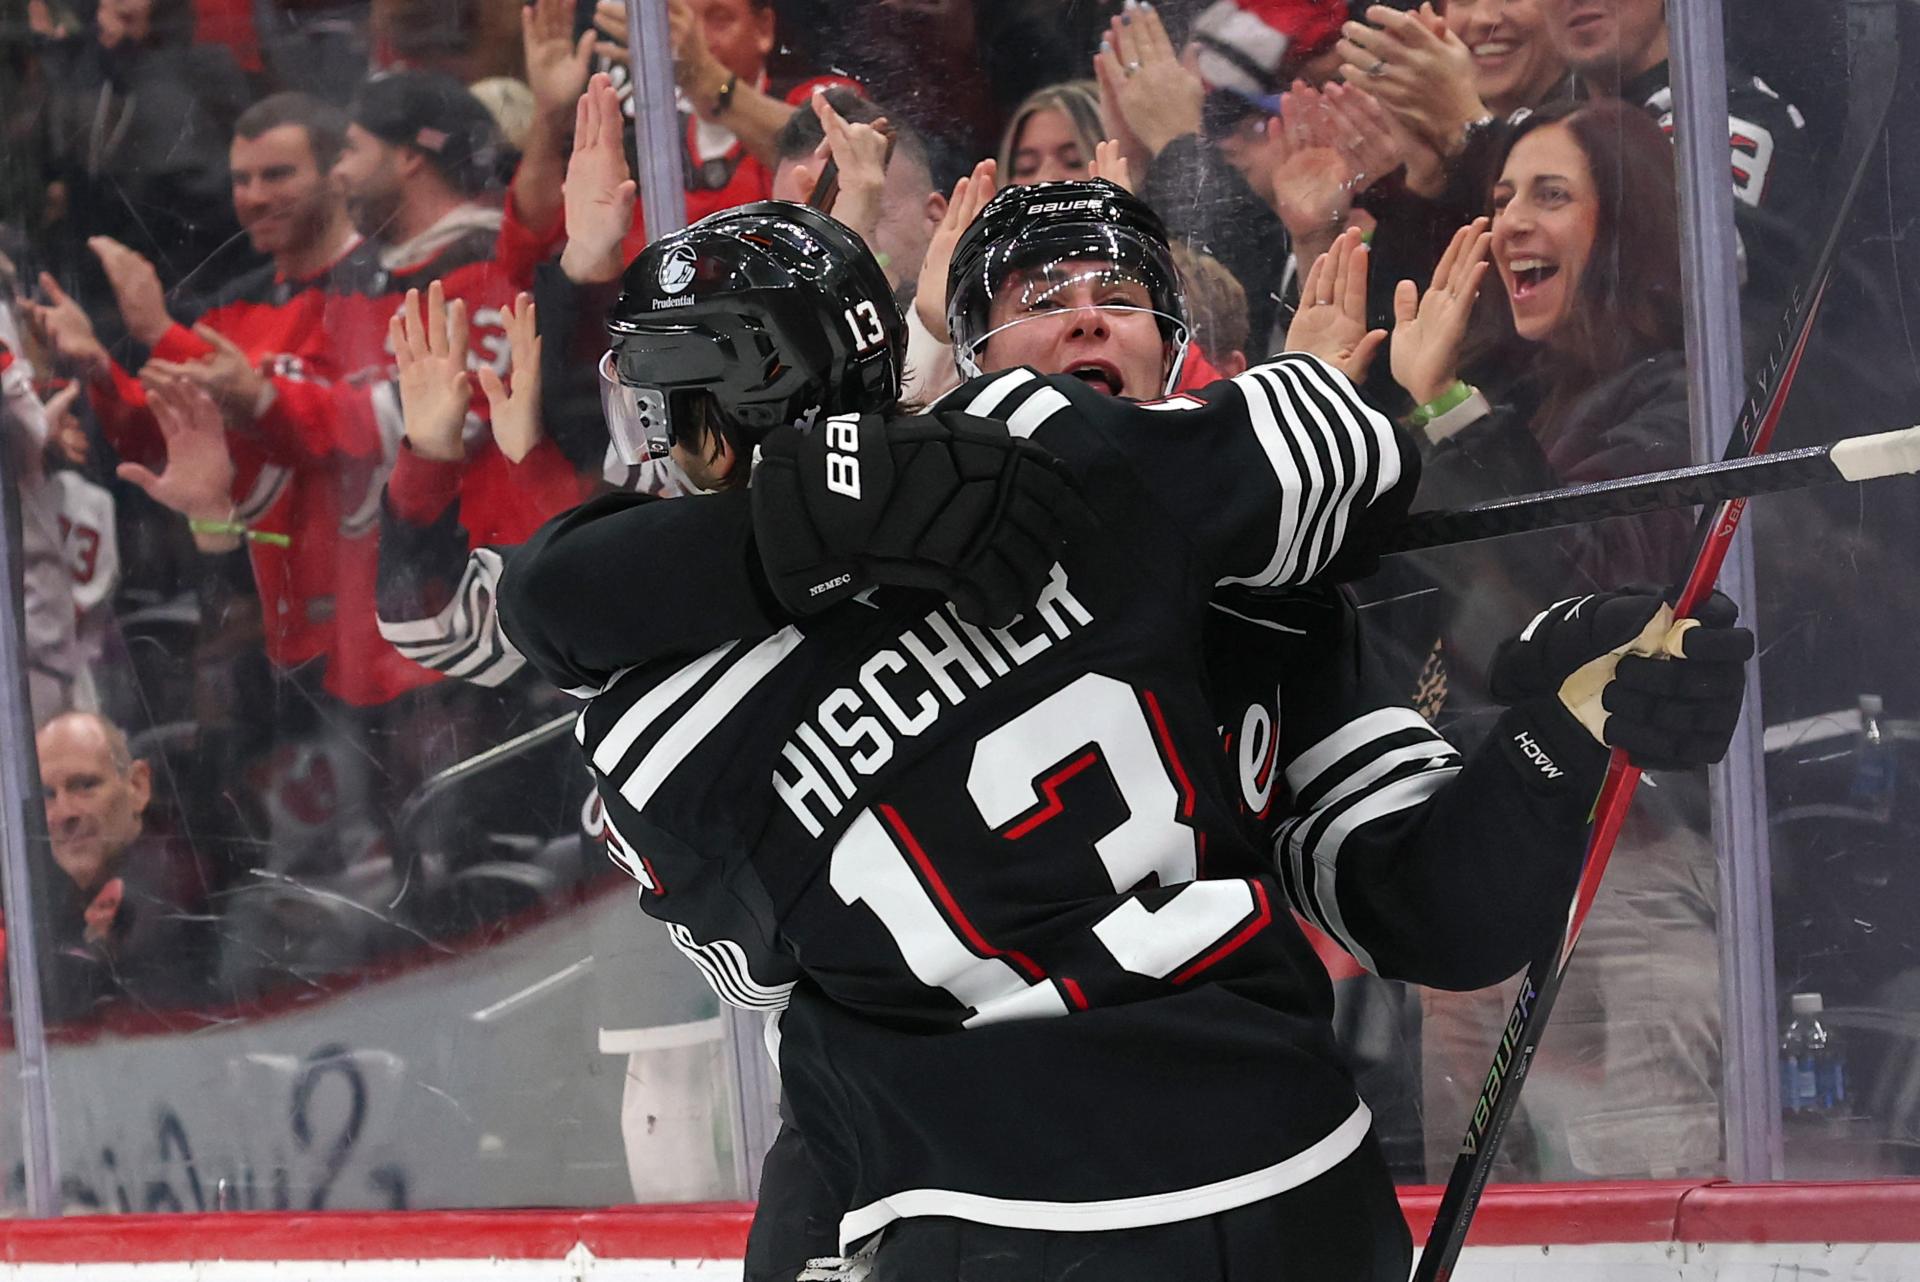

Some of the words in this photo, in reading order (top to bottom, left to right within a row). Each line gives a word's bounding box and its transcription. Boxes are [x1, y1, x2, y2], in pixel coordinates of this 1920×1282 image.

[652, 293, 695, 310] Prudential
[845, 300, 884, 351] 13
[809, 573, 851, 597] NEMEC
[772, 561, 1094, 839] HISCHIER
[1514, 731, 1564, 779] MACH
[829, 672, 1266, 1031] 13
